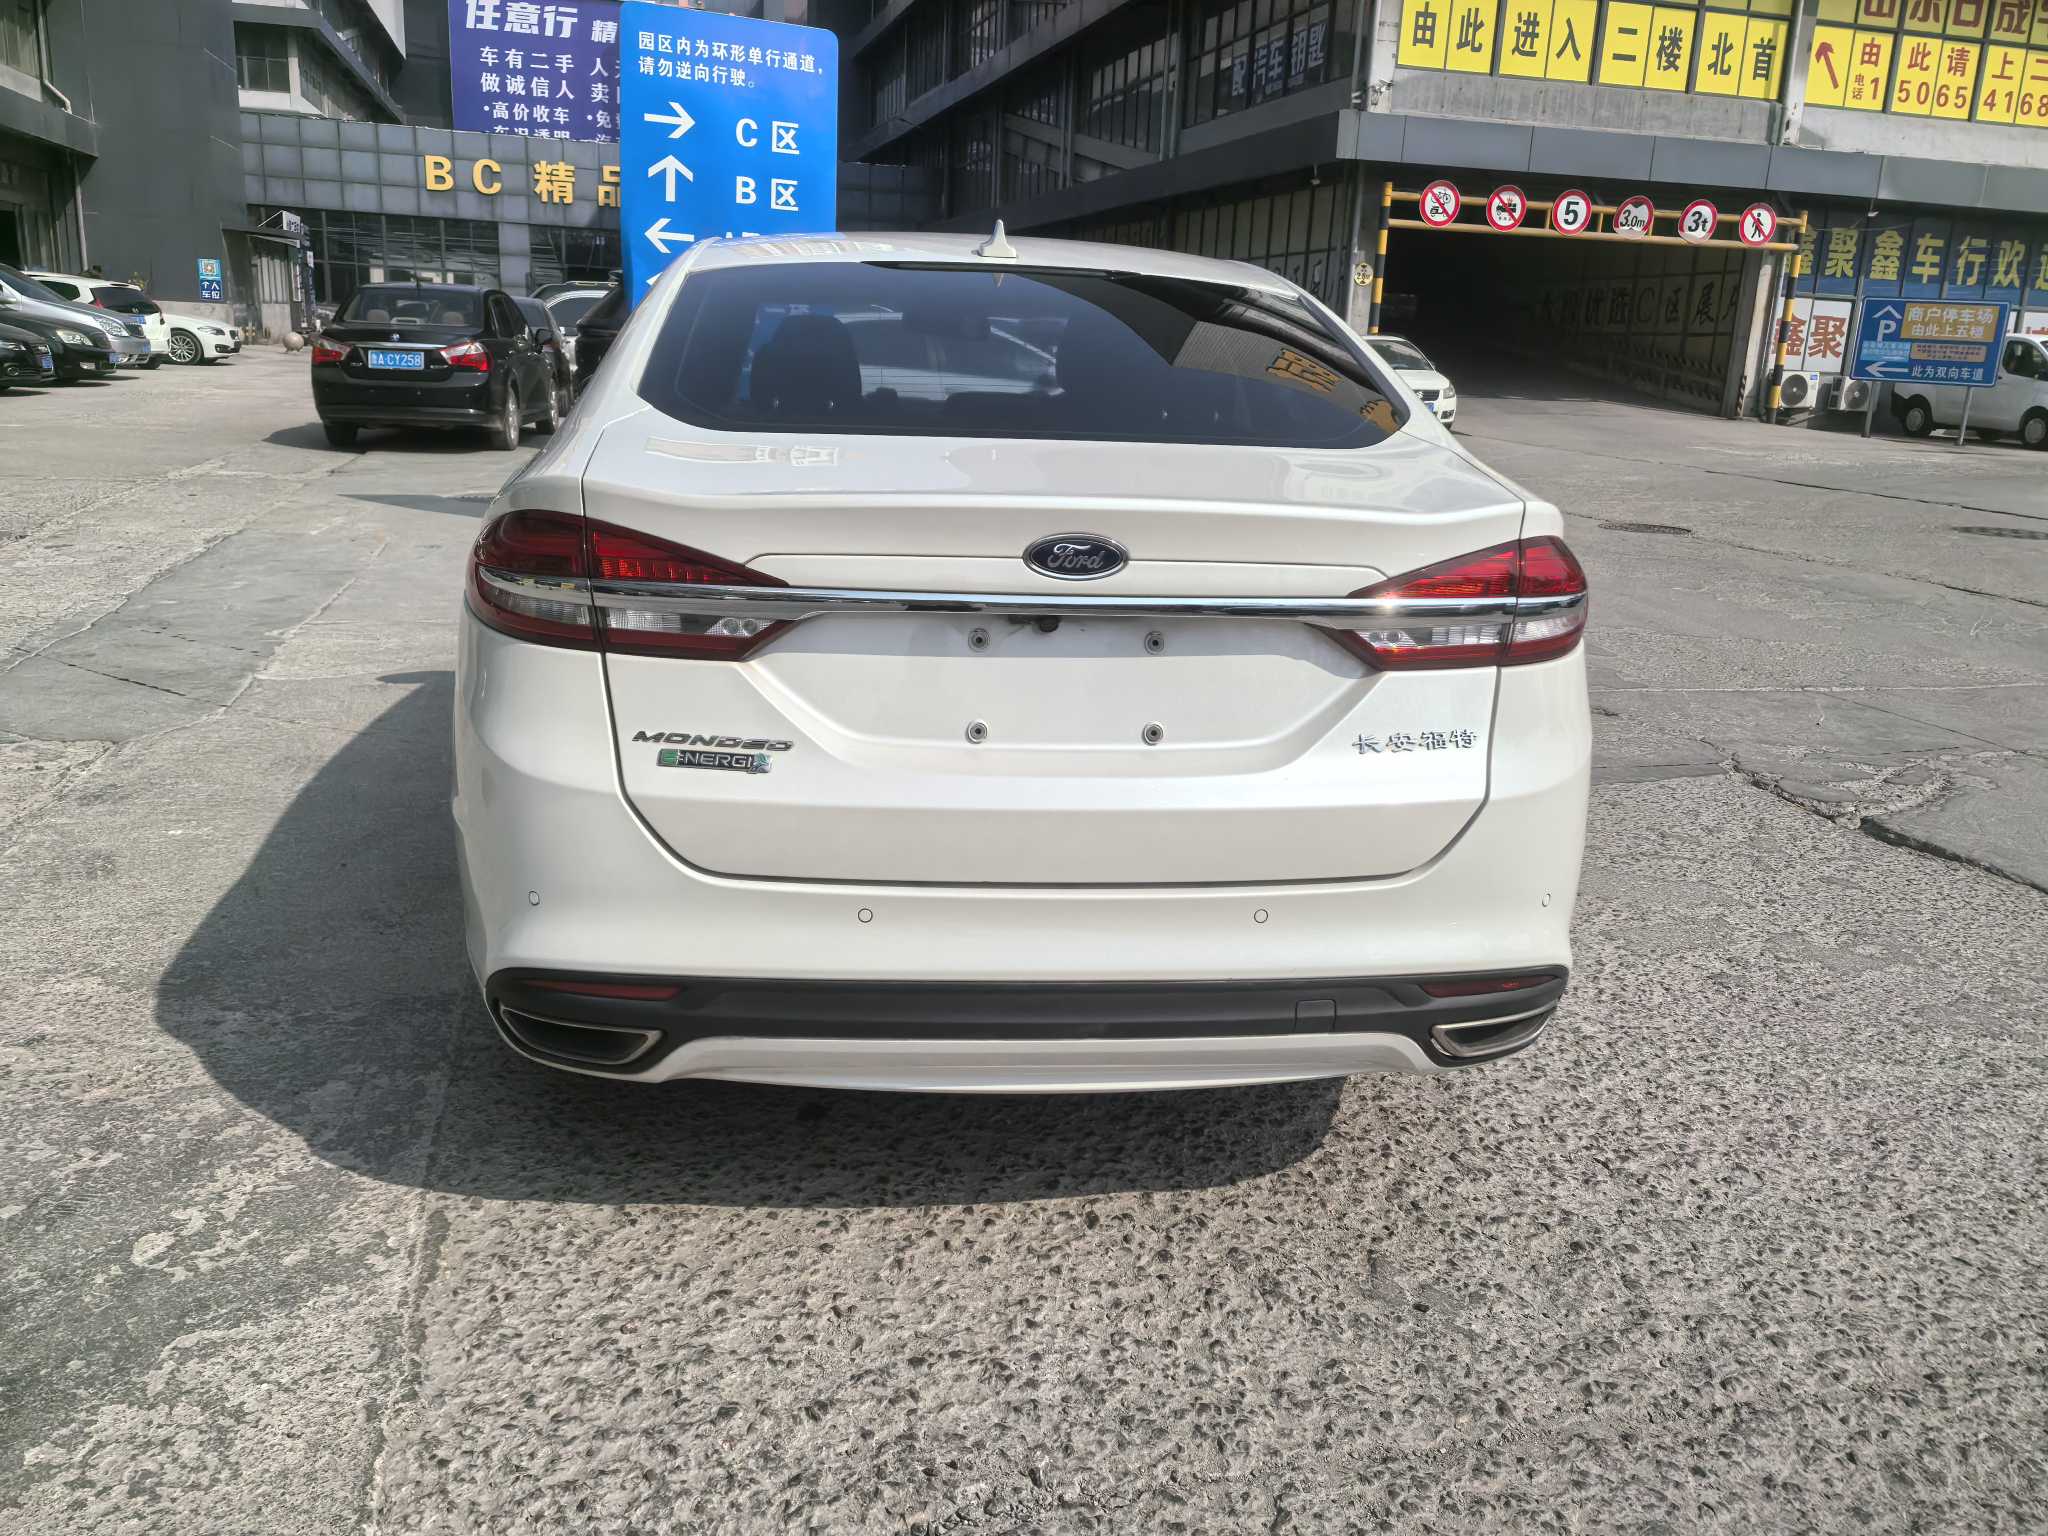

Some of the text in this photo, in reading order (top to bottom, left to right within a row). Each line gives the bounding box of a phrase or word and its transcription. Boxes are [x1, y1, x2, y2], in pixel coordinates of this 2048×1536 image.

[465, 0, 578, 38] 任意行
[1411, 1, 1777, 82] 由此进入二楼北首
[480, 46, 575, 73] 车有二手
[638, 56, 755, 88] 请勿逆向行驶。
[480, 72, 575, 100] 做诚信人
[1852, 74, 1865, 101] 电话
[1563, 200, 1580, 226] 5
[1619, 209, 1646, 229] 3.0m
[1688, 210, 1709, 233] 3t
[1908, 306, 1993, 325] 商户停车场
[1911, 364, 1984, 381] 此为双向车道
[1047, 543, 1106, 569] Ford
[632, 730, 793, 752] MONDEO
[1352, 728, 1477, 754] 长安福特
